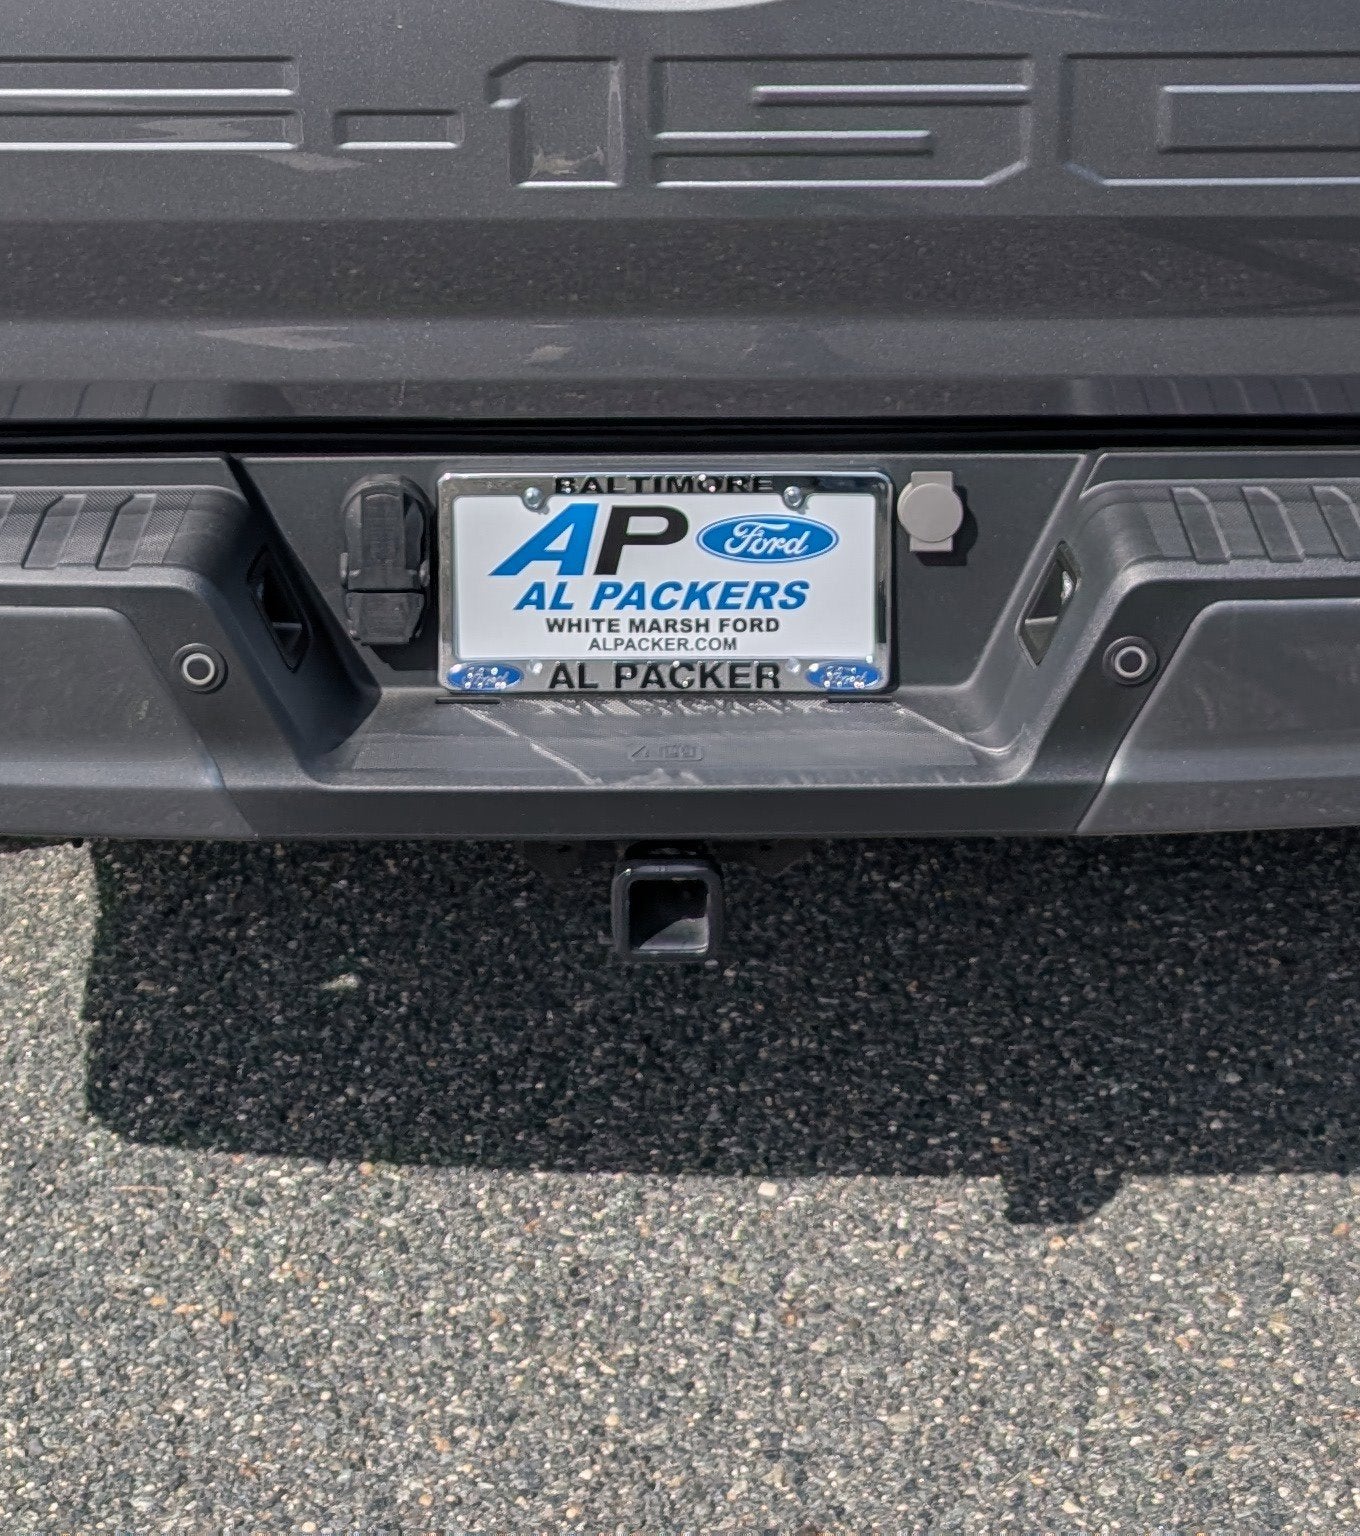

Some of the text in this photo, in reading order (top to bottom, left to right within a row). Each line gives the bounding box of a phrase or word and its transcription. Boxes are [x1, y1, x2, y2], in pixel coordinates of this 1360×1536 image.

[554, 474, 775, 494] BALTIMORE
[489, 502, 689, 576] AP
[723, 520, 811, 555] Ford
[513, 579, 810, 611] AL PACKERS
[545, 616, 781, 634] WHITE MARSH FORD
[587, 636, 738, 652] ALPACKER.COM
[547, 661, 781, 690] AL PACKER
